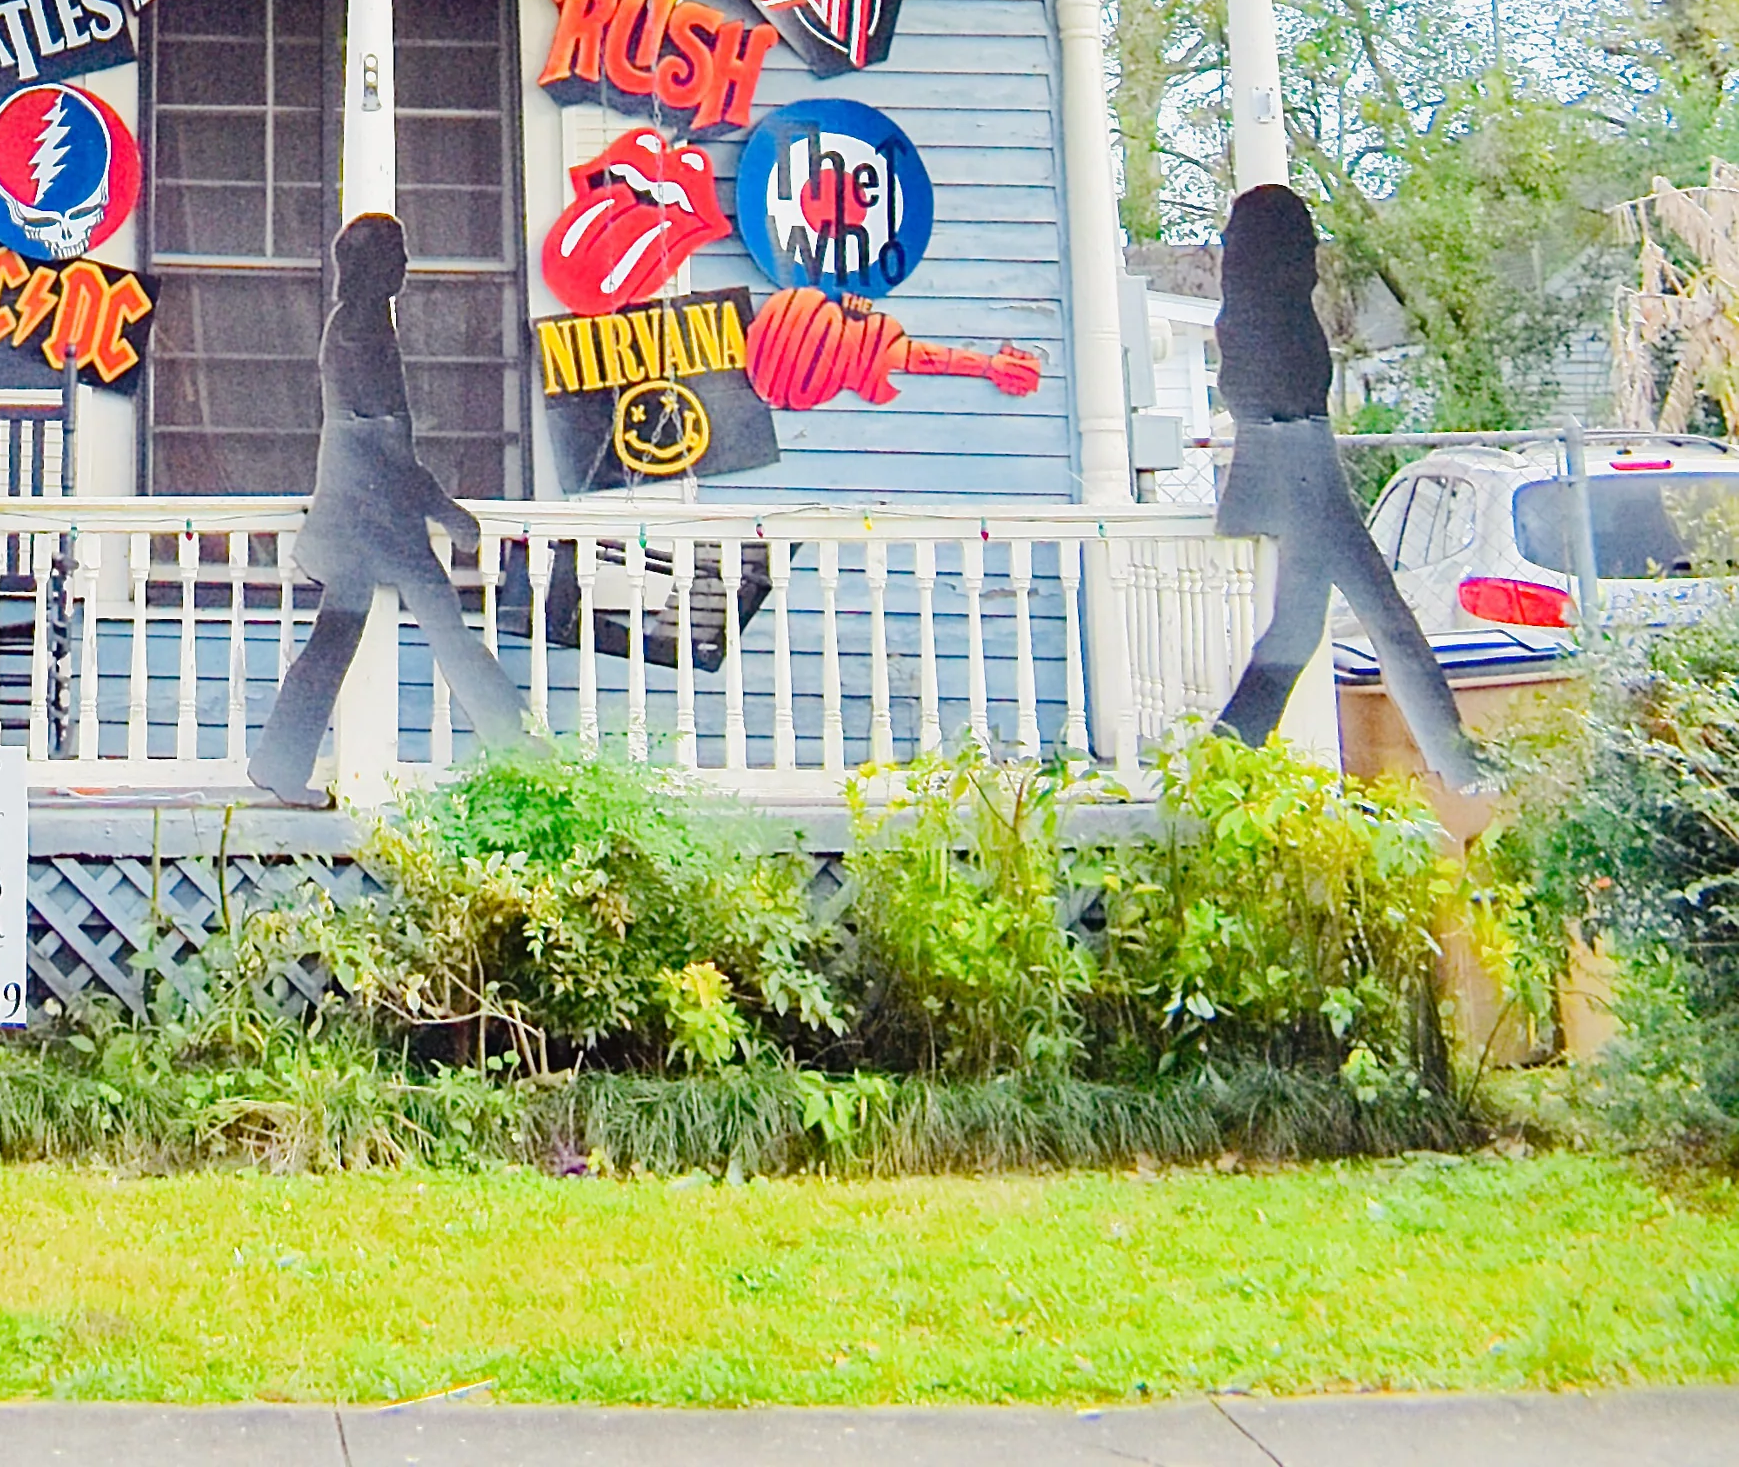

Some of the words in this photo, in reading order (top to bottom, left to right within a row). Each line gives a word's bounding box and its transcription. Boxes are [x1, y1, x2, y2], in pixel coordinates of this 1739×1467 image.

[763, 120, 880, 207] The
[842, 292, 874, 314] THE
[536, 299, 747, 395] NIRVANA
